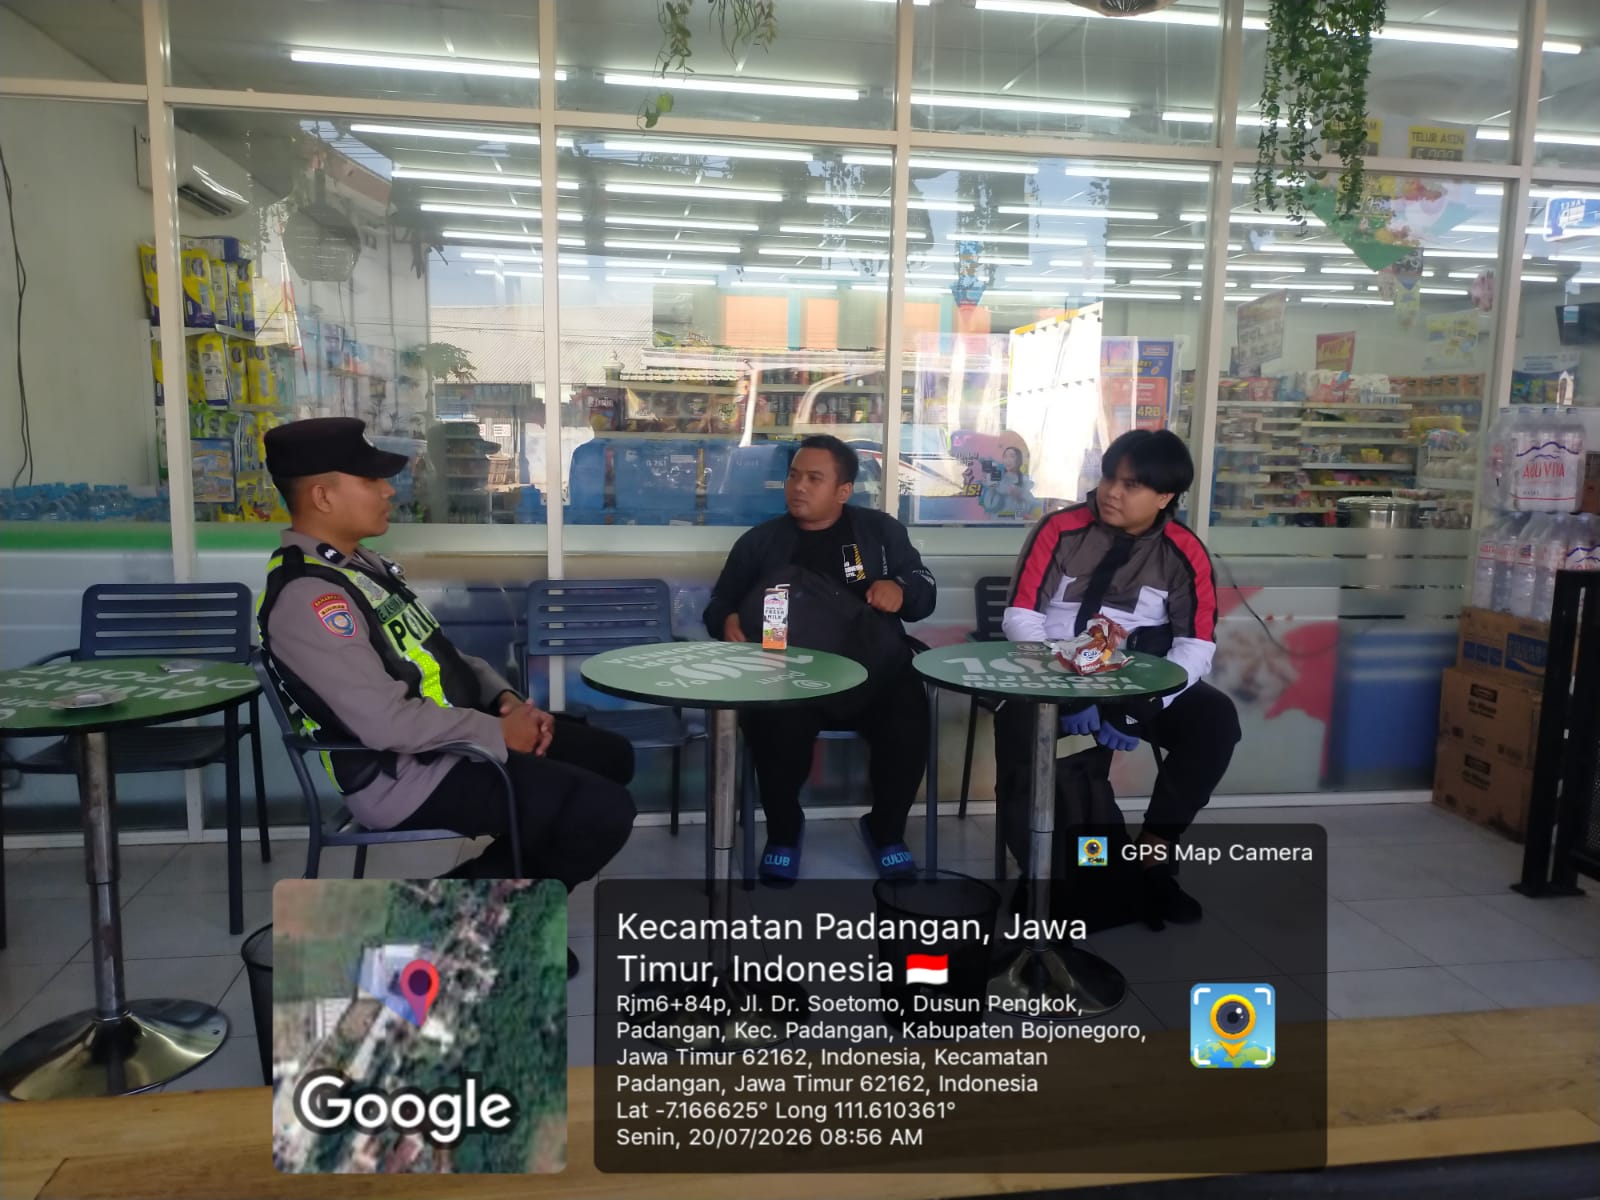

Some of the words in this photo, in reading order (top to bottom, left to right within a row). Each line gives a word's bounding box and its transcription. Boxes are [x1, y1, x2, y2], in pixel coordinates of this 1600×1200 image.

[176, 676, 261, 690] ON
[962, 674, 1026, 682] BIJI
[1039, 675, 1132, 683] KOPI
[963, 681, 1147, 691] INDONESIA
[764, 853, 791, 867] CLUB
